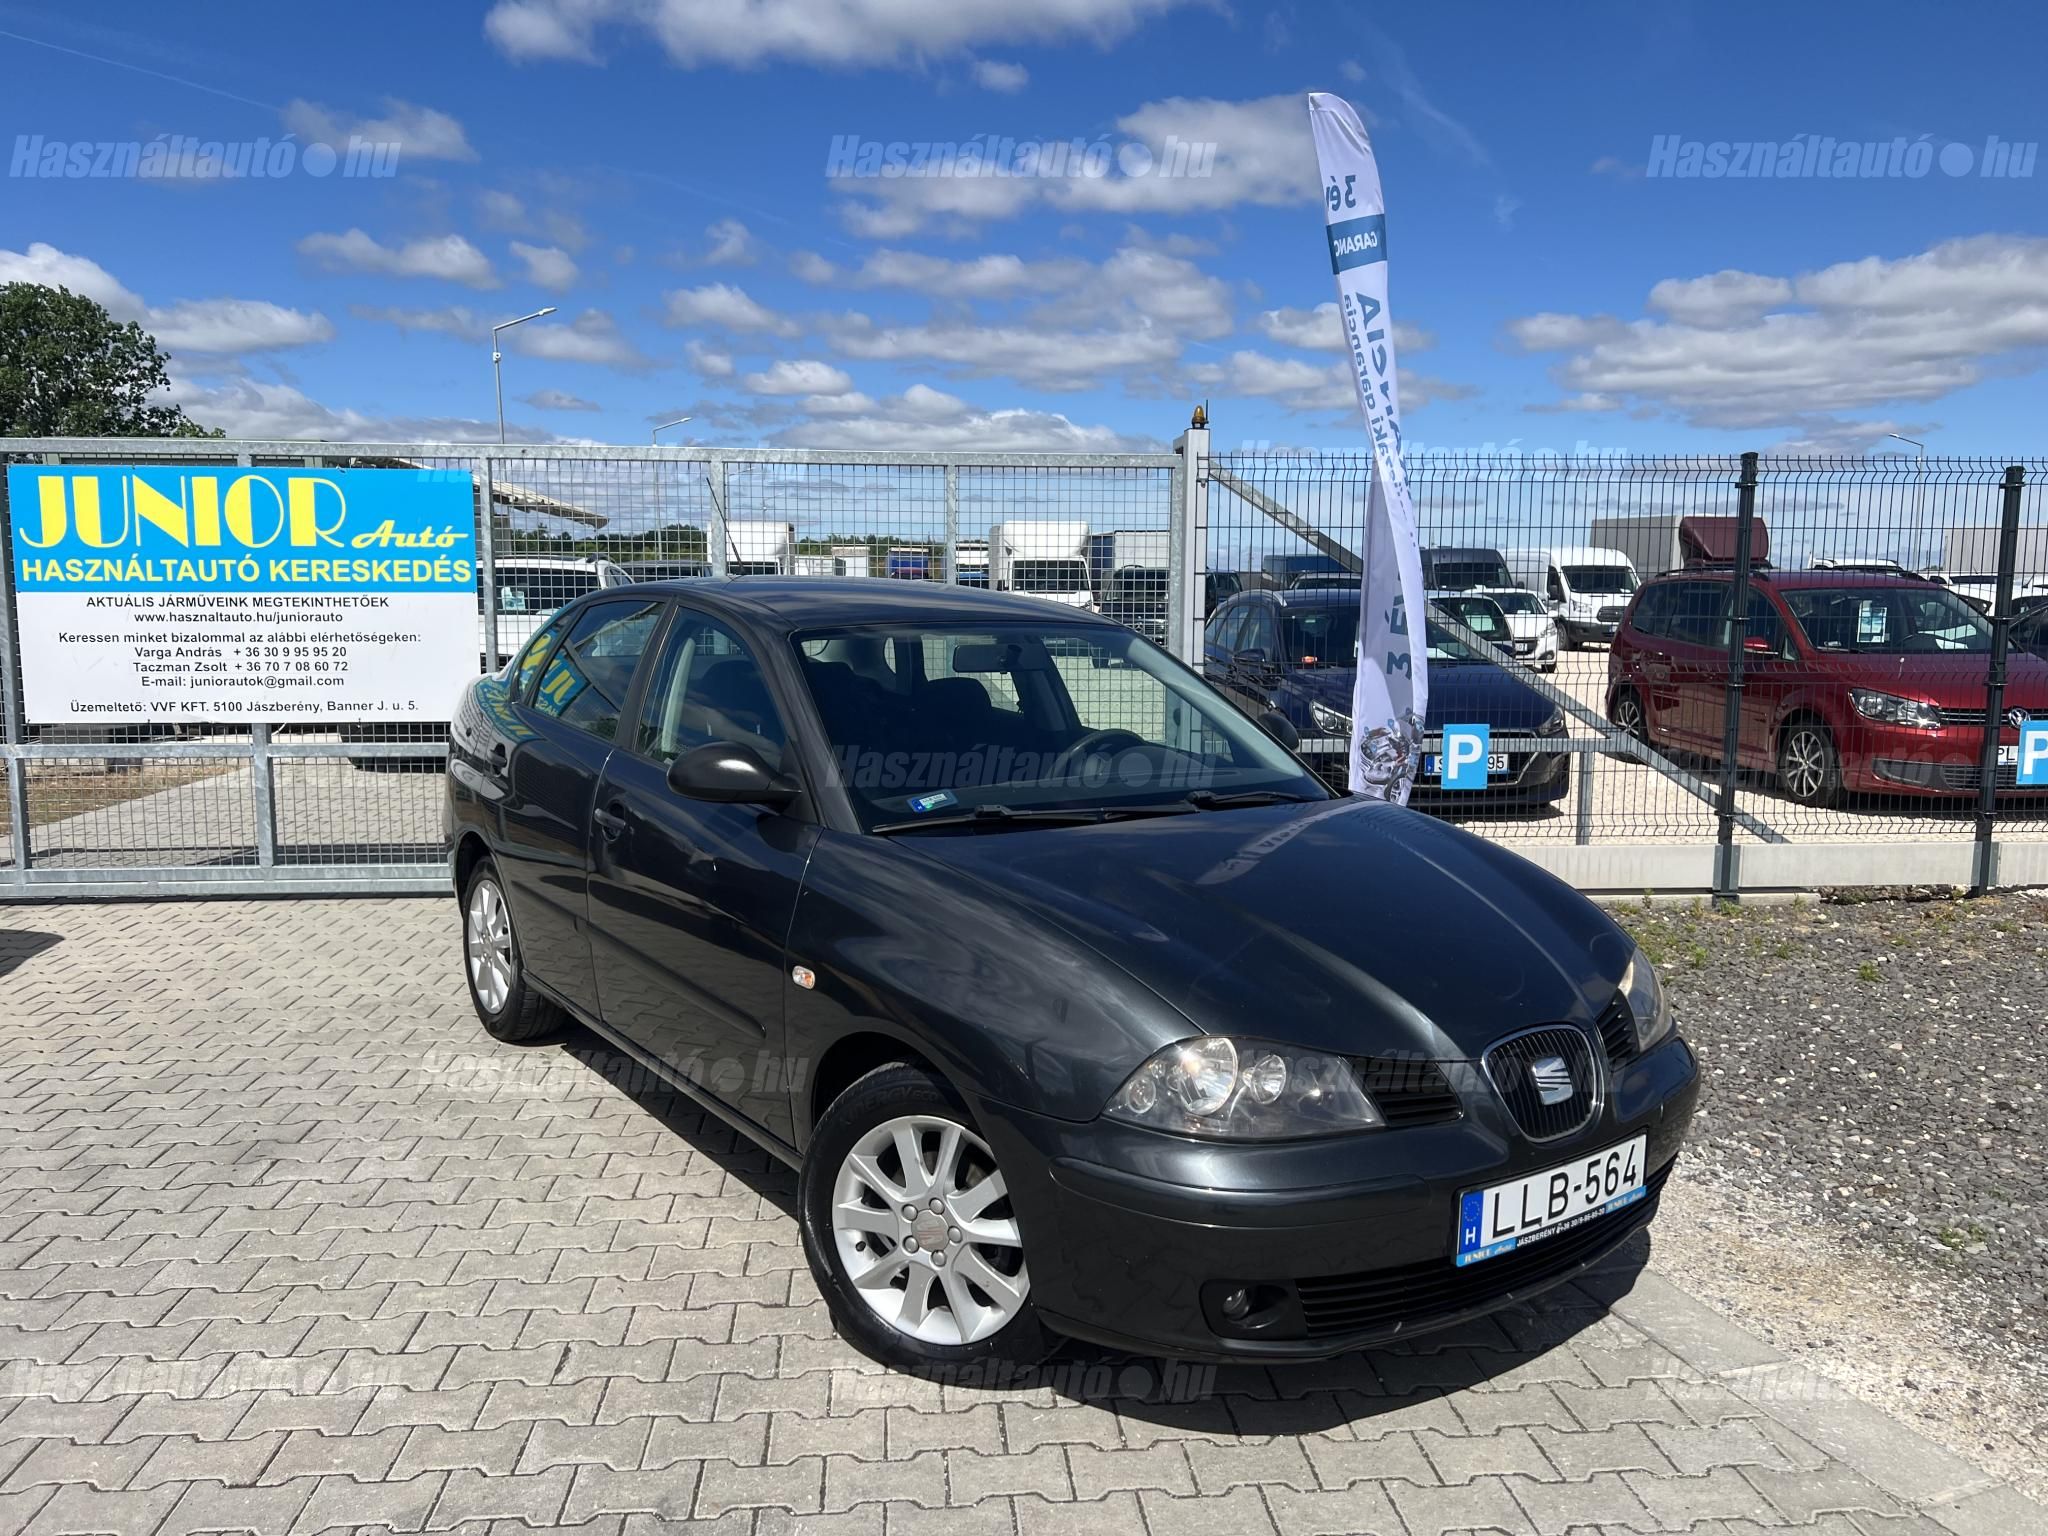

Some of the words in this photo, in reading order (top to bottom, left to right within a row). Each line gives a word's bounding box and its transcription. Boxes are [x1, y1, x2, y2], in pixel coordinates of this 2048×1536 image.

[19, 474, 345, 548] JUNIOR
[351, 519, 469, 549] Autó
[21, 553, 260, 582] HASZNÁLTAUTÓ
[269, 554, 471, 583] KERESKEDÉS
[86, 594, 154, 607] AKTUÁLIS
[158, 594, 248, 607] JÁRMŰVEINK
[252, 594, 389, 607] MEGTEKINTHETŐEK
[134, 611, 343, 624] www.hasznaltauto.hu/juniorauto
[59, 632, 119, 643] Keressen
[123, 632, 168, 643] minket
[171, 632, 245, 643] bizalommal
[249, 634, 263, 643] az
[267, 632, 306, 643] alábbi
[310, 632, 422, 645] elérhetőségeken:
[134, 647, 172, 659] Varga
[175, 646, 222, 657] András
[245, 646, 260, 657] 36
[264, 646, 279, 657] 30
[282, 646, 290, 657] 9
[294, 646, 309, 657] 95
[313, 646, 328, 657] 95
[332, 646, 347, 657] 20
[133, 662, 190, 672] Taczman
[194, 661, 228, 672] Zsolt
[246, 661, 261, 671] 36
[265, 661, 280, 671] 70
[284, 661, 291, 671] 7
[295, 661, 310, 671] 08
[314, 661, 329, 671] 60
[333, 661, 349, 671] 72
[141, 676, 187, 686] E-mail:
[190, 675, 344, 689] juniorautok@gmail.com
[70, 699, 147, 712] Üzemeltető:
[150, 701, 176, 712] VVF
[180, 701, 209, 712] KFT.
[213, 701, 243, 712] 5100
[246, 701, 323, 714] Jászberény,
[327, 700, 374, 711] Banner
[377, 700, 388, 711] J.
[392, 702, 403, 711] u.
[408, 700, 419, 710] 5.
[1447, 733, 1483, 780] P
[2022, 730, 2048, 775] P
[1493, 1143, 1636, 1238] LLB-564
[1465, 1226, 1476, 1246] H
